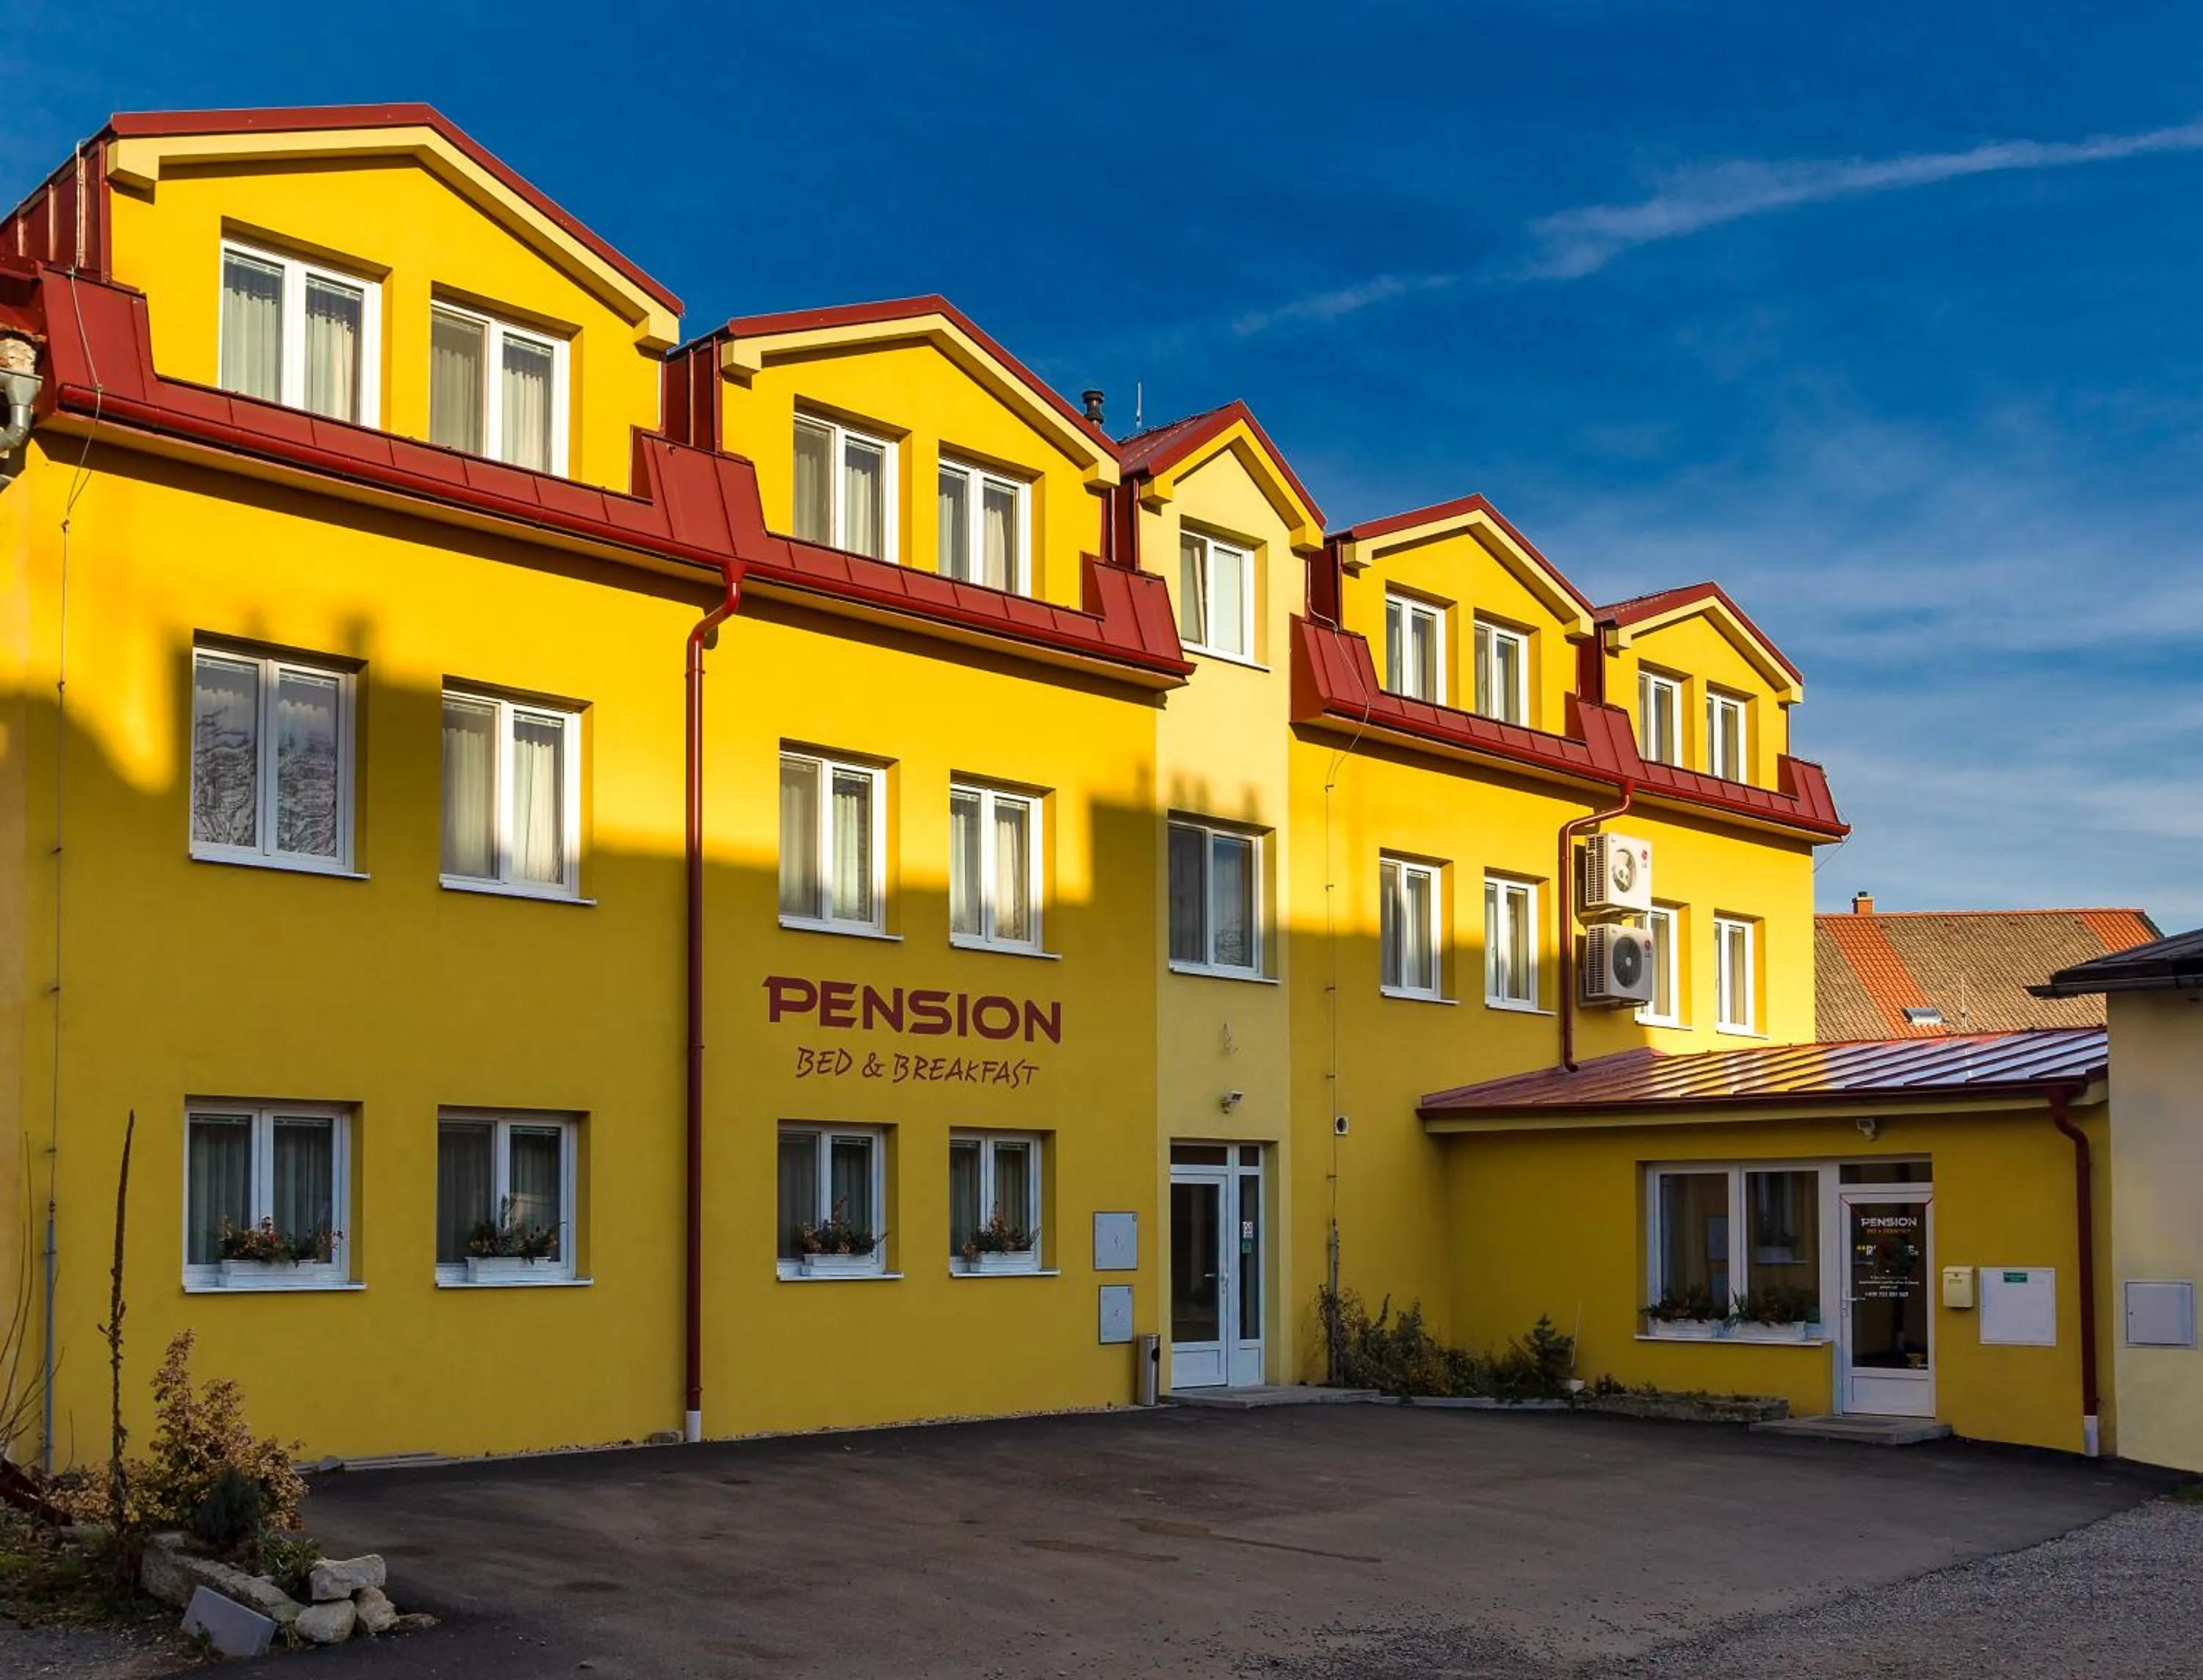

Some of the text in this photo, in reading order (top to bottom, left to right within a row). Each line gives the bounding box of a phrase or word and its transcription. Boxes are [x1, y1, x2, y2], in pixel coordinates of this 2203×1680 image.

[762, 975, 1061, 1043] PENSION
[796, 1046, 1039, 1089] BED & BREAKFAST
[1860, 1217, 1917, 1227] PENSION
